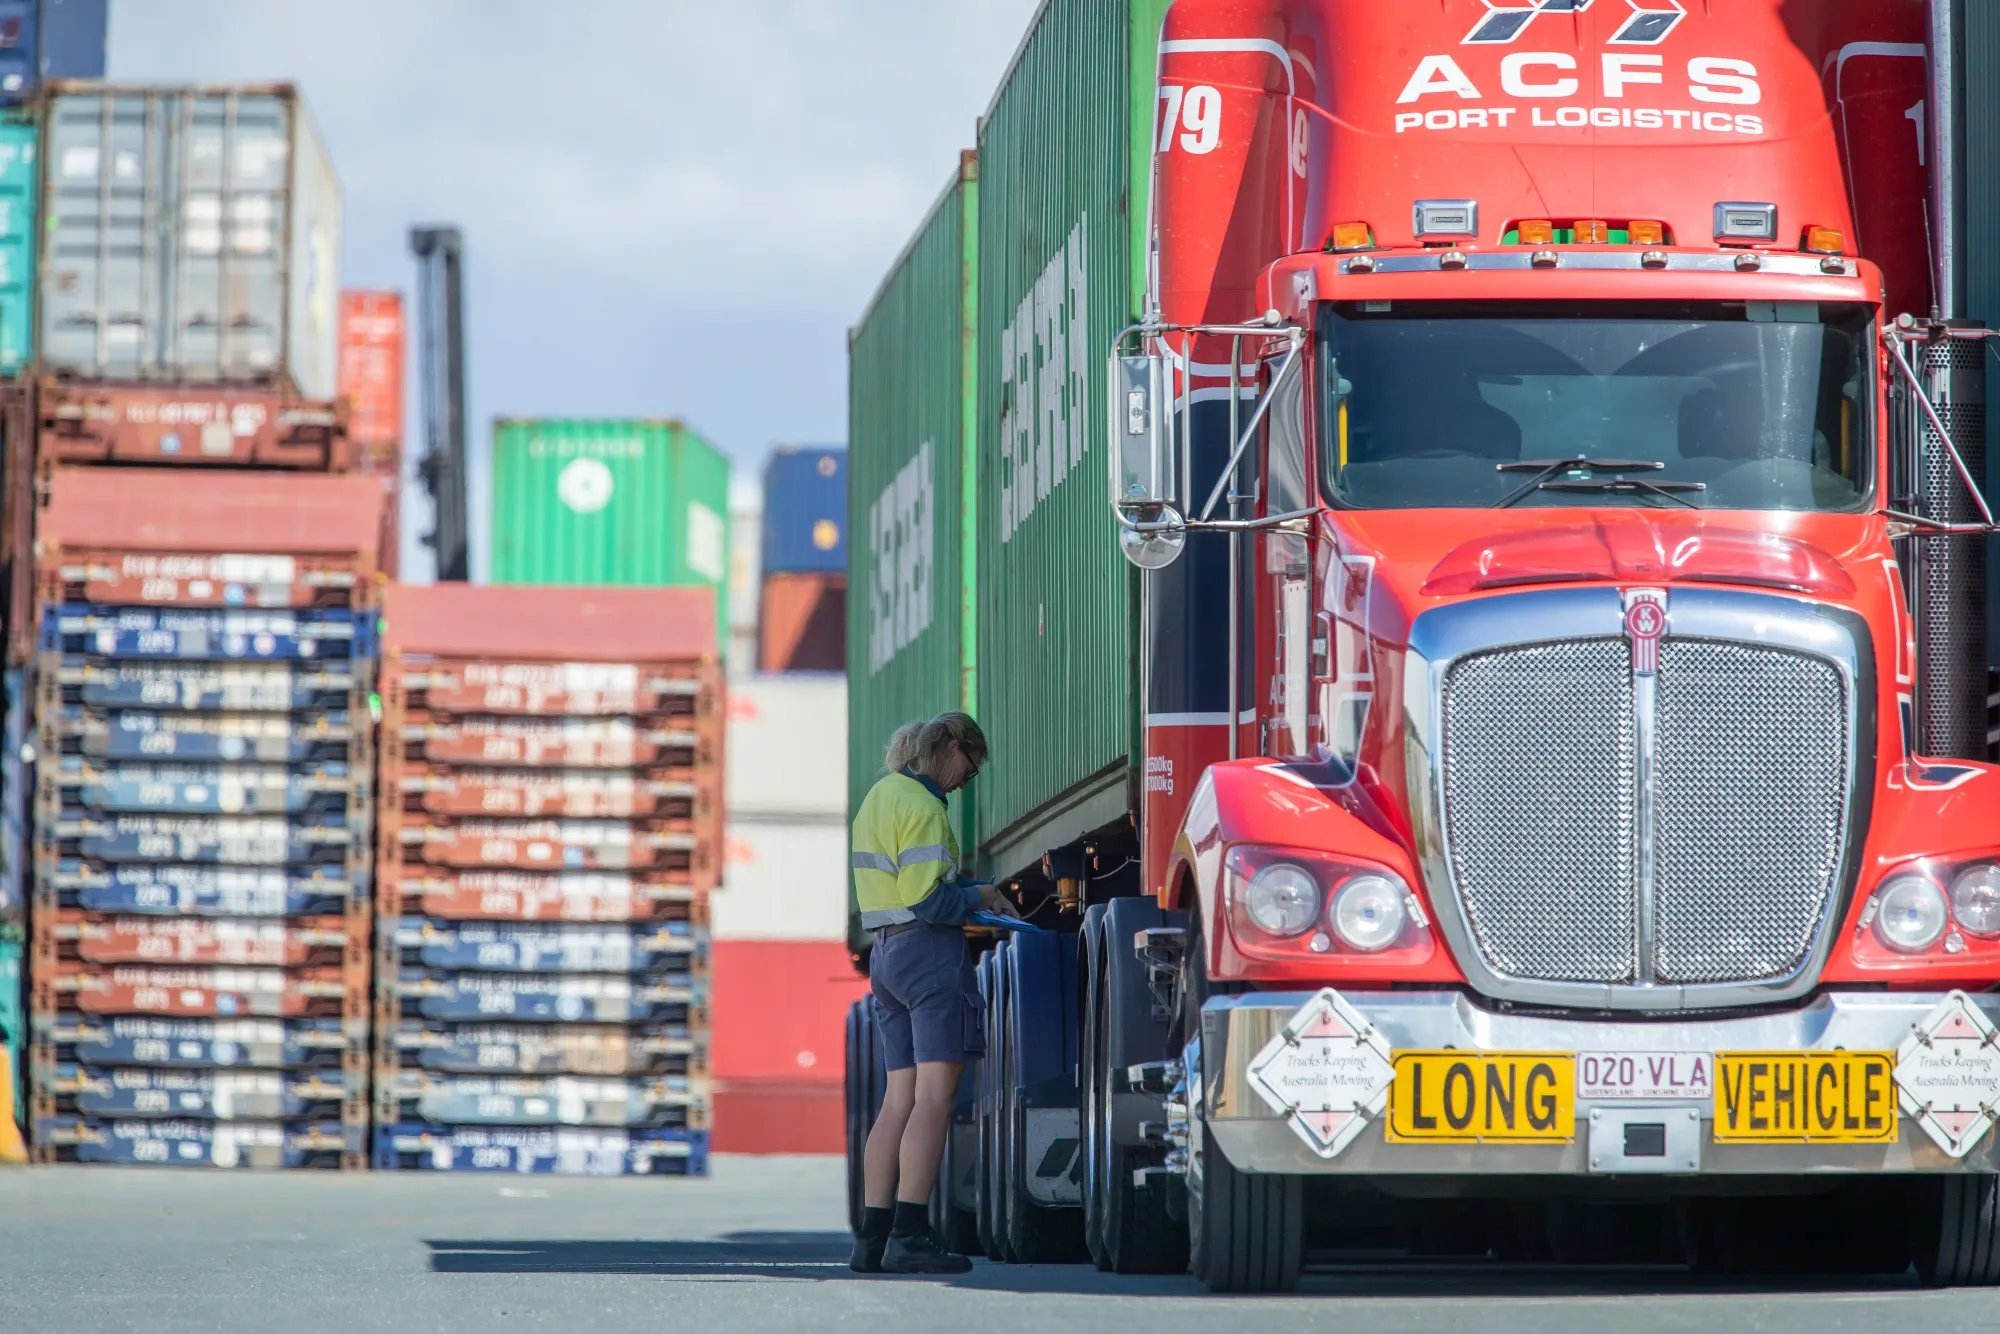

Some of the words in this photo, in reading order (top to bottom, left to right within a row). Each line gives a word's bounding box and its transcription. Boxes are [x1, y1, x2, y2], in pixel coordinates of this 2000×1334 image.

[1395, 51, 1761, 105] ACFS
[1395, 107, 1516, 133] PORT
[1532, 107, 1763, 134] LOGISTICS
[1288, 1055, 1321, 1067] Trucks
[1323, 1055, 1367, 1071] Keeping
[1919, 1056, 1951, 1068] Trucks
[1954, 1056, 1992, 1072] Keeping
[1279, 1075, 1328, 1087] Australia
[1330, 1075, 1375, 1091] Moving
[1914, 1075, 1959, 1088] Australia
[1960, 1075, 1998, 1092] Moving
[1412, 1062, 1557, 1131] LONG
[1721, 1062, 1883, 1131] VEHICLE
